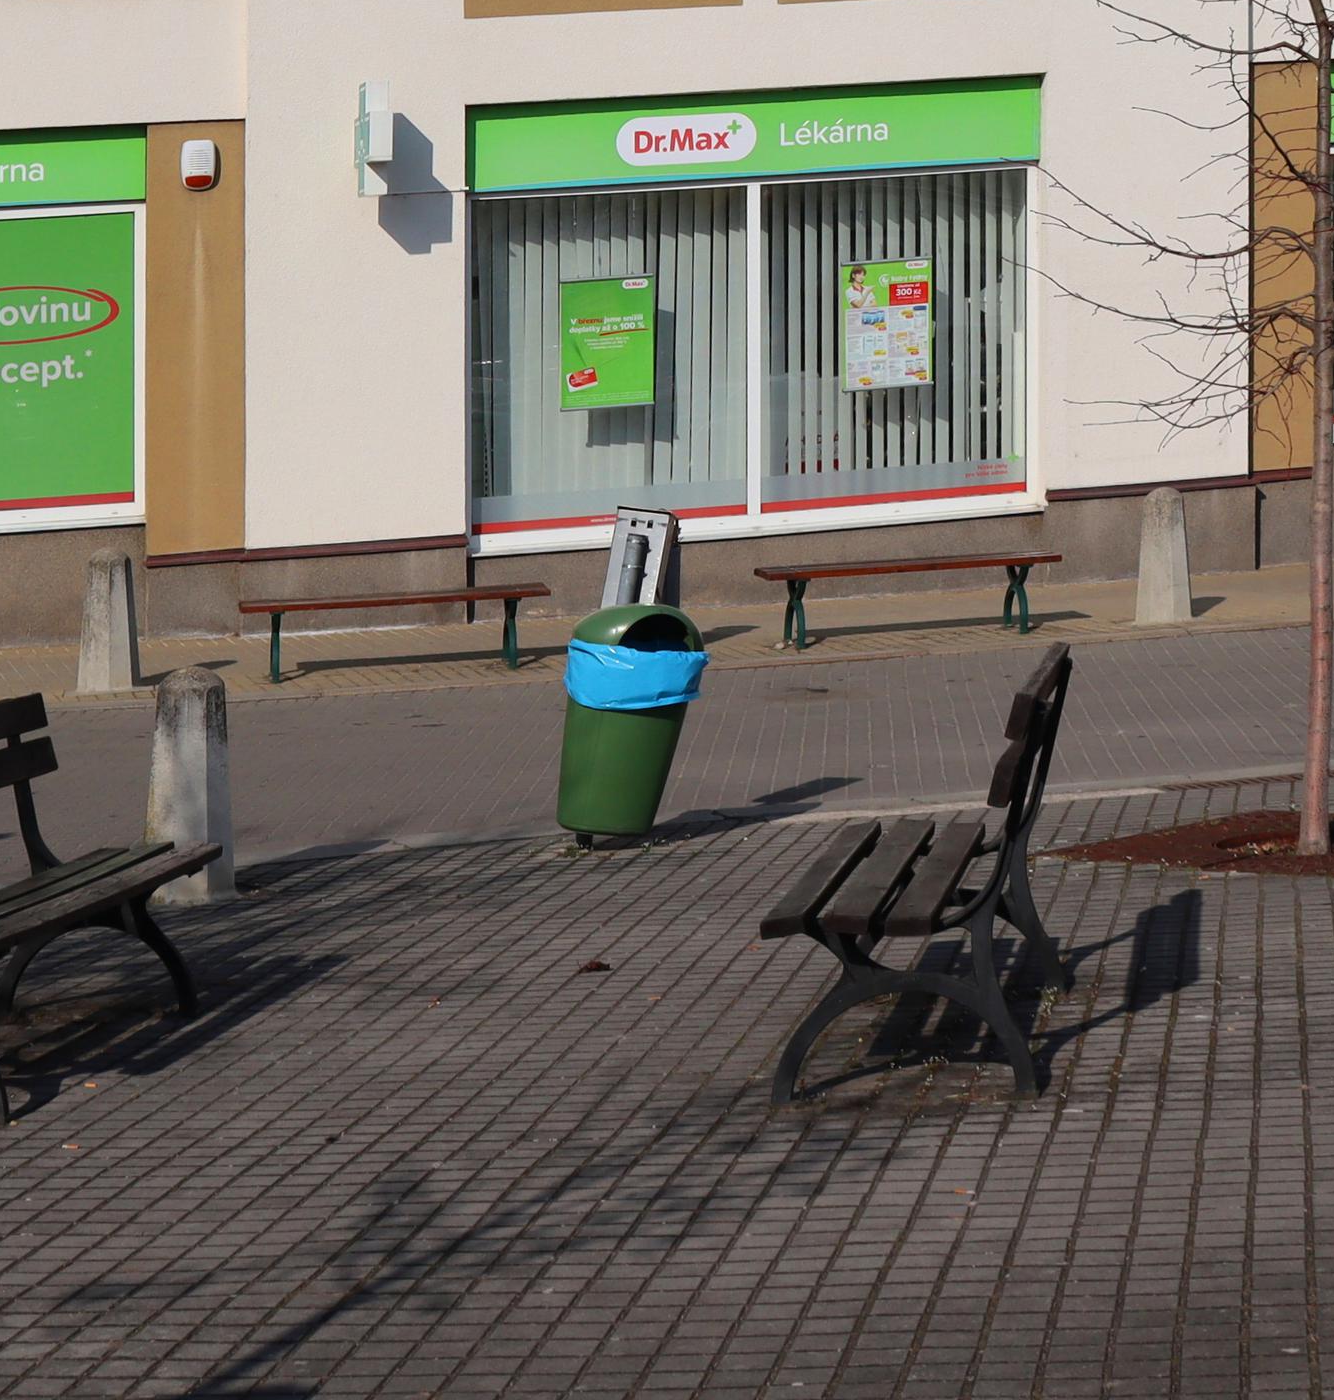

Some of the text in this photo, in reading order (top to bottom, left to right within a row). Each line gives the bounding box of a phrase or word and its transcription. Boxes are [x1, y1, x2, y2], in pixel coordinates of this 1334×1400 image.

[634, 118, 889, 154] Dr.Max Lékárna
[895, 288, 912, 296] 300
[619, 322, 636, 330] 100
